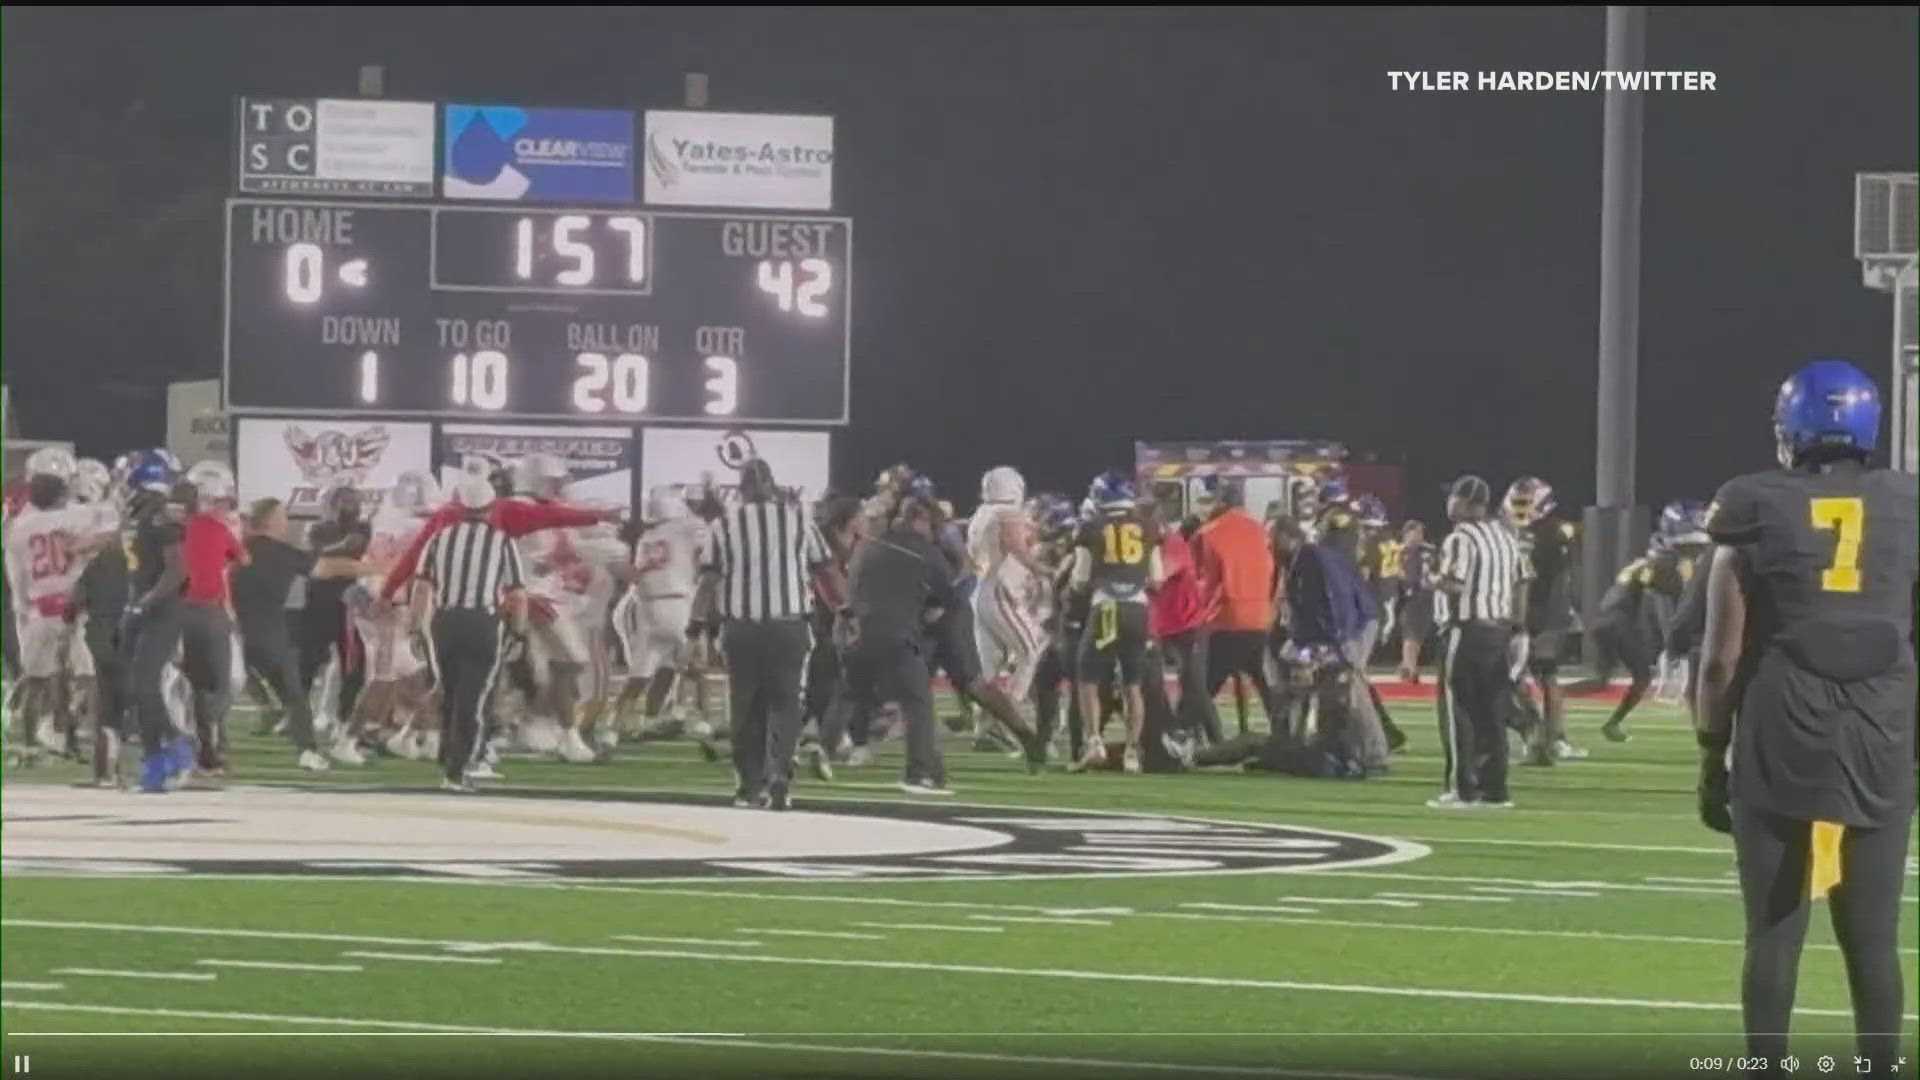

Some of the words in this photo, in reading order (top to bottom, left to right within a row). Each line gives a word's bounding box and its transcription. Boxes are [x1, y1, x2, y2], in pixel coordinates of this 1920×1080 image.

[672, 137, 834, 164] Yates-Astro
[252, 207, 355, 245] HOME
[722, 221, 833, 258] GUEST
[285, 242, 323, 303] 0
[757, 258, 833, 319] 42
[322, 315, 400, 345] DOWN
[436, 318, 469, 347] TO
[475, 320, 511, 350] GO
[567, 323, 623, 350] BALL
[627, 325, 660, 352] ON
[361, 351, 378, 403] 1
[452, 350, 508, 410] 10
[573, 352, 649, 413] 20
[704, 356, 738, 416] 3
[1103, 522, 1144, 564] 16
[1810, 497, 1864, 592] 7
